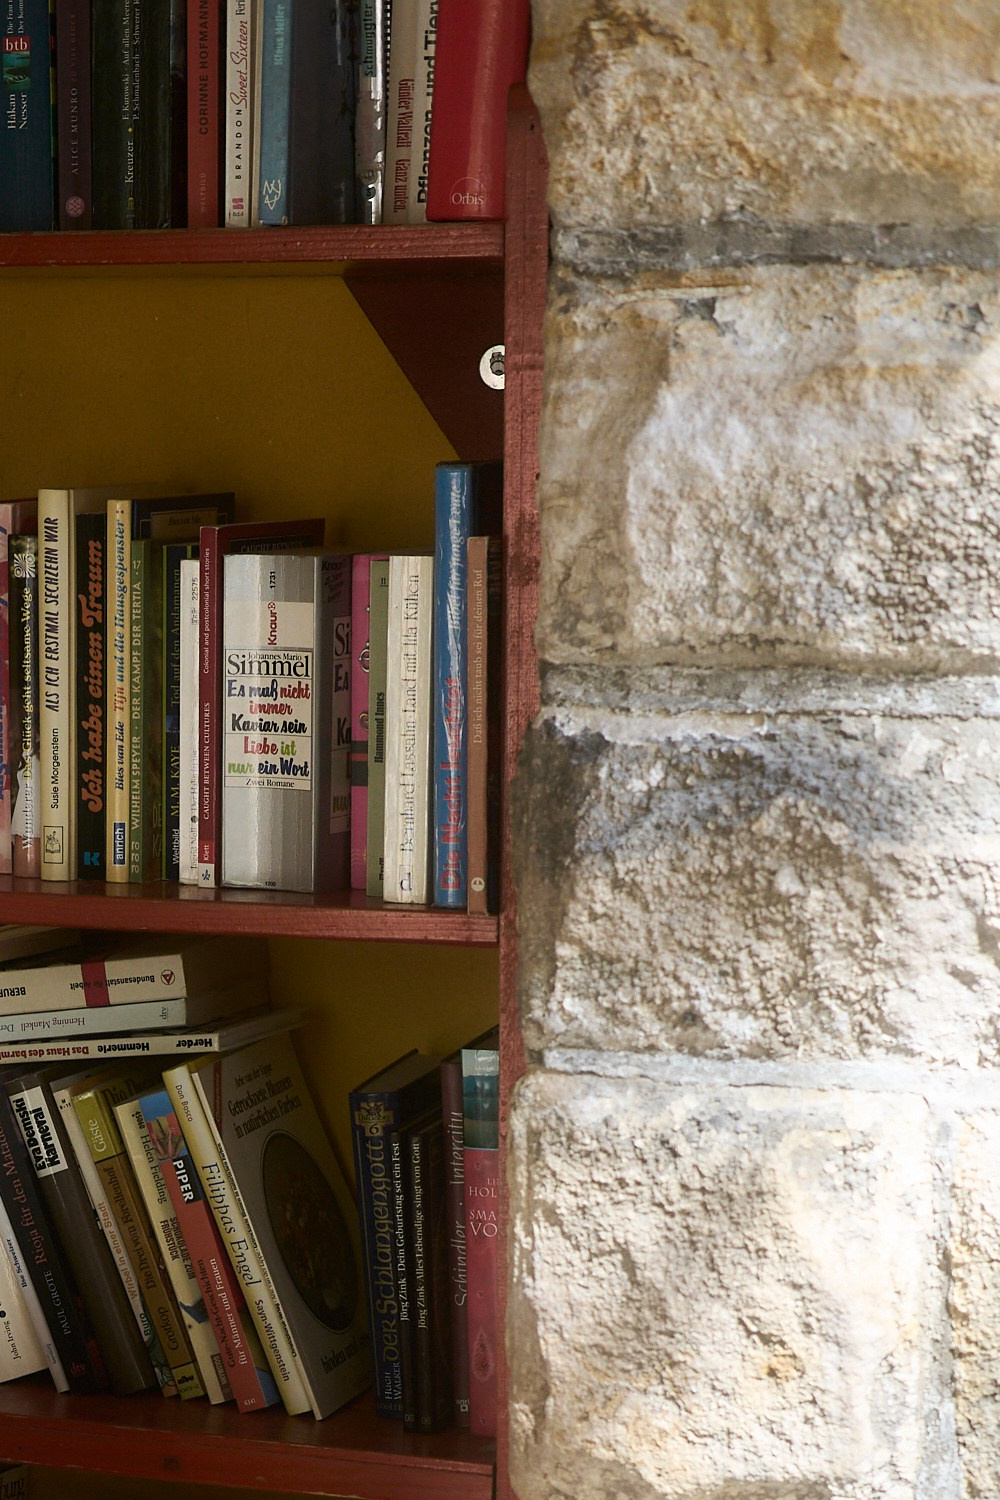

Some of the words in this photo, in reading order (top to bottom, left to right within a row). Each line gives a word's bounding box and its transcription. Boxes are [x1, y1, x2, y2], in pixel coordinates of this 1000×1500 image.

[5, 38, 28, 50] btb
[363, 3, 377, 77] Schmuggler
[7, 94, 16, 129] Håkan
[19, 93, 28, 129] Nesser
[70, 87, 78, 133] MUNRO
[200, 74, 209, 135] CORINNE
[71, 139, 79, 176] ALICE
[125, 140, 134, 184] Kreuzer
[452, 193, 483, 205] Orbis
[44, 517, 58, 543] WAR
[45, 547, 59, 606] SECHZEHN
[78, 540, 103, 628] Traum
[132, 581, 141, 619] TERTIA
[45, 611, 59, 661] ERSTMAL
[132, 625, 141, 645] DER
[45, 666, 60, 688] ICH
[83, 632, 103, 699] einen
[132, 648, 141, 693] KAMPF
[228, 654, 310, 677] Simmel
[228, 680, 245, 697] Es
[249, 679, 278, 699] muß
[280, 681, 310, 699] nicht
[231, 714, 279, 733] Kaviar
[281, 720, 307, 734] sein
[250, 701, 292, 714] immer
[51, 728, 61, 783] Morgenstern
[132, 735, 140, 776] SPEYER
[244, 736, 278, 755] Liebe
[281, 741, 296, 755] ist
[246, 778, 265, 787] Zwei
[266, 779, 294, 788] Romane
[258, 761, 279, 775] ein
[280, 758, 309, 777] Wort
[51, 784, 59, 809] Susie
[131, 779, 140, 829] WILHELM
[115, 827, 124, 860] anrich
[172, 828, 180, 865] Weltbild
[0, 987, 27, 998] BERUF
[50, 1046, 70, 1055] Haus
[72, 1046, 89, 1054] Das
[98, 1042, 150, 1052] Hemmerle
[176, 1038, 213, 1048] Herder
[172, 1159, 195, 1202] PIPER
[202, 1163, 236, 1234] Filippas
[230, 1238, 262, 1287] Engel
